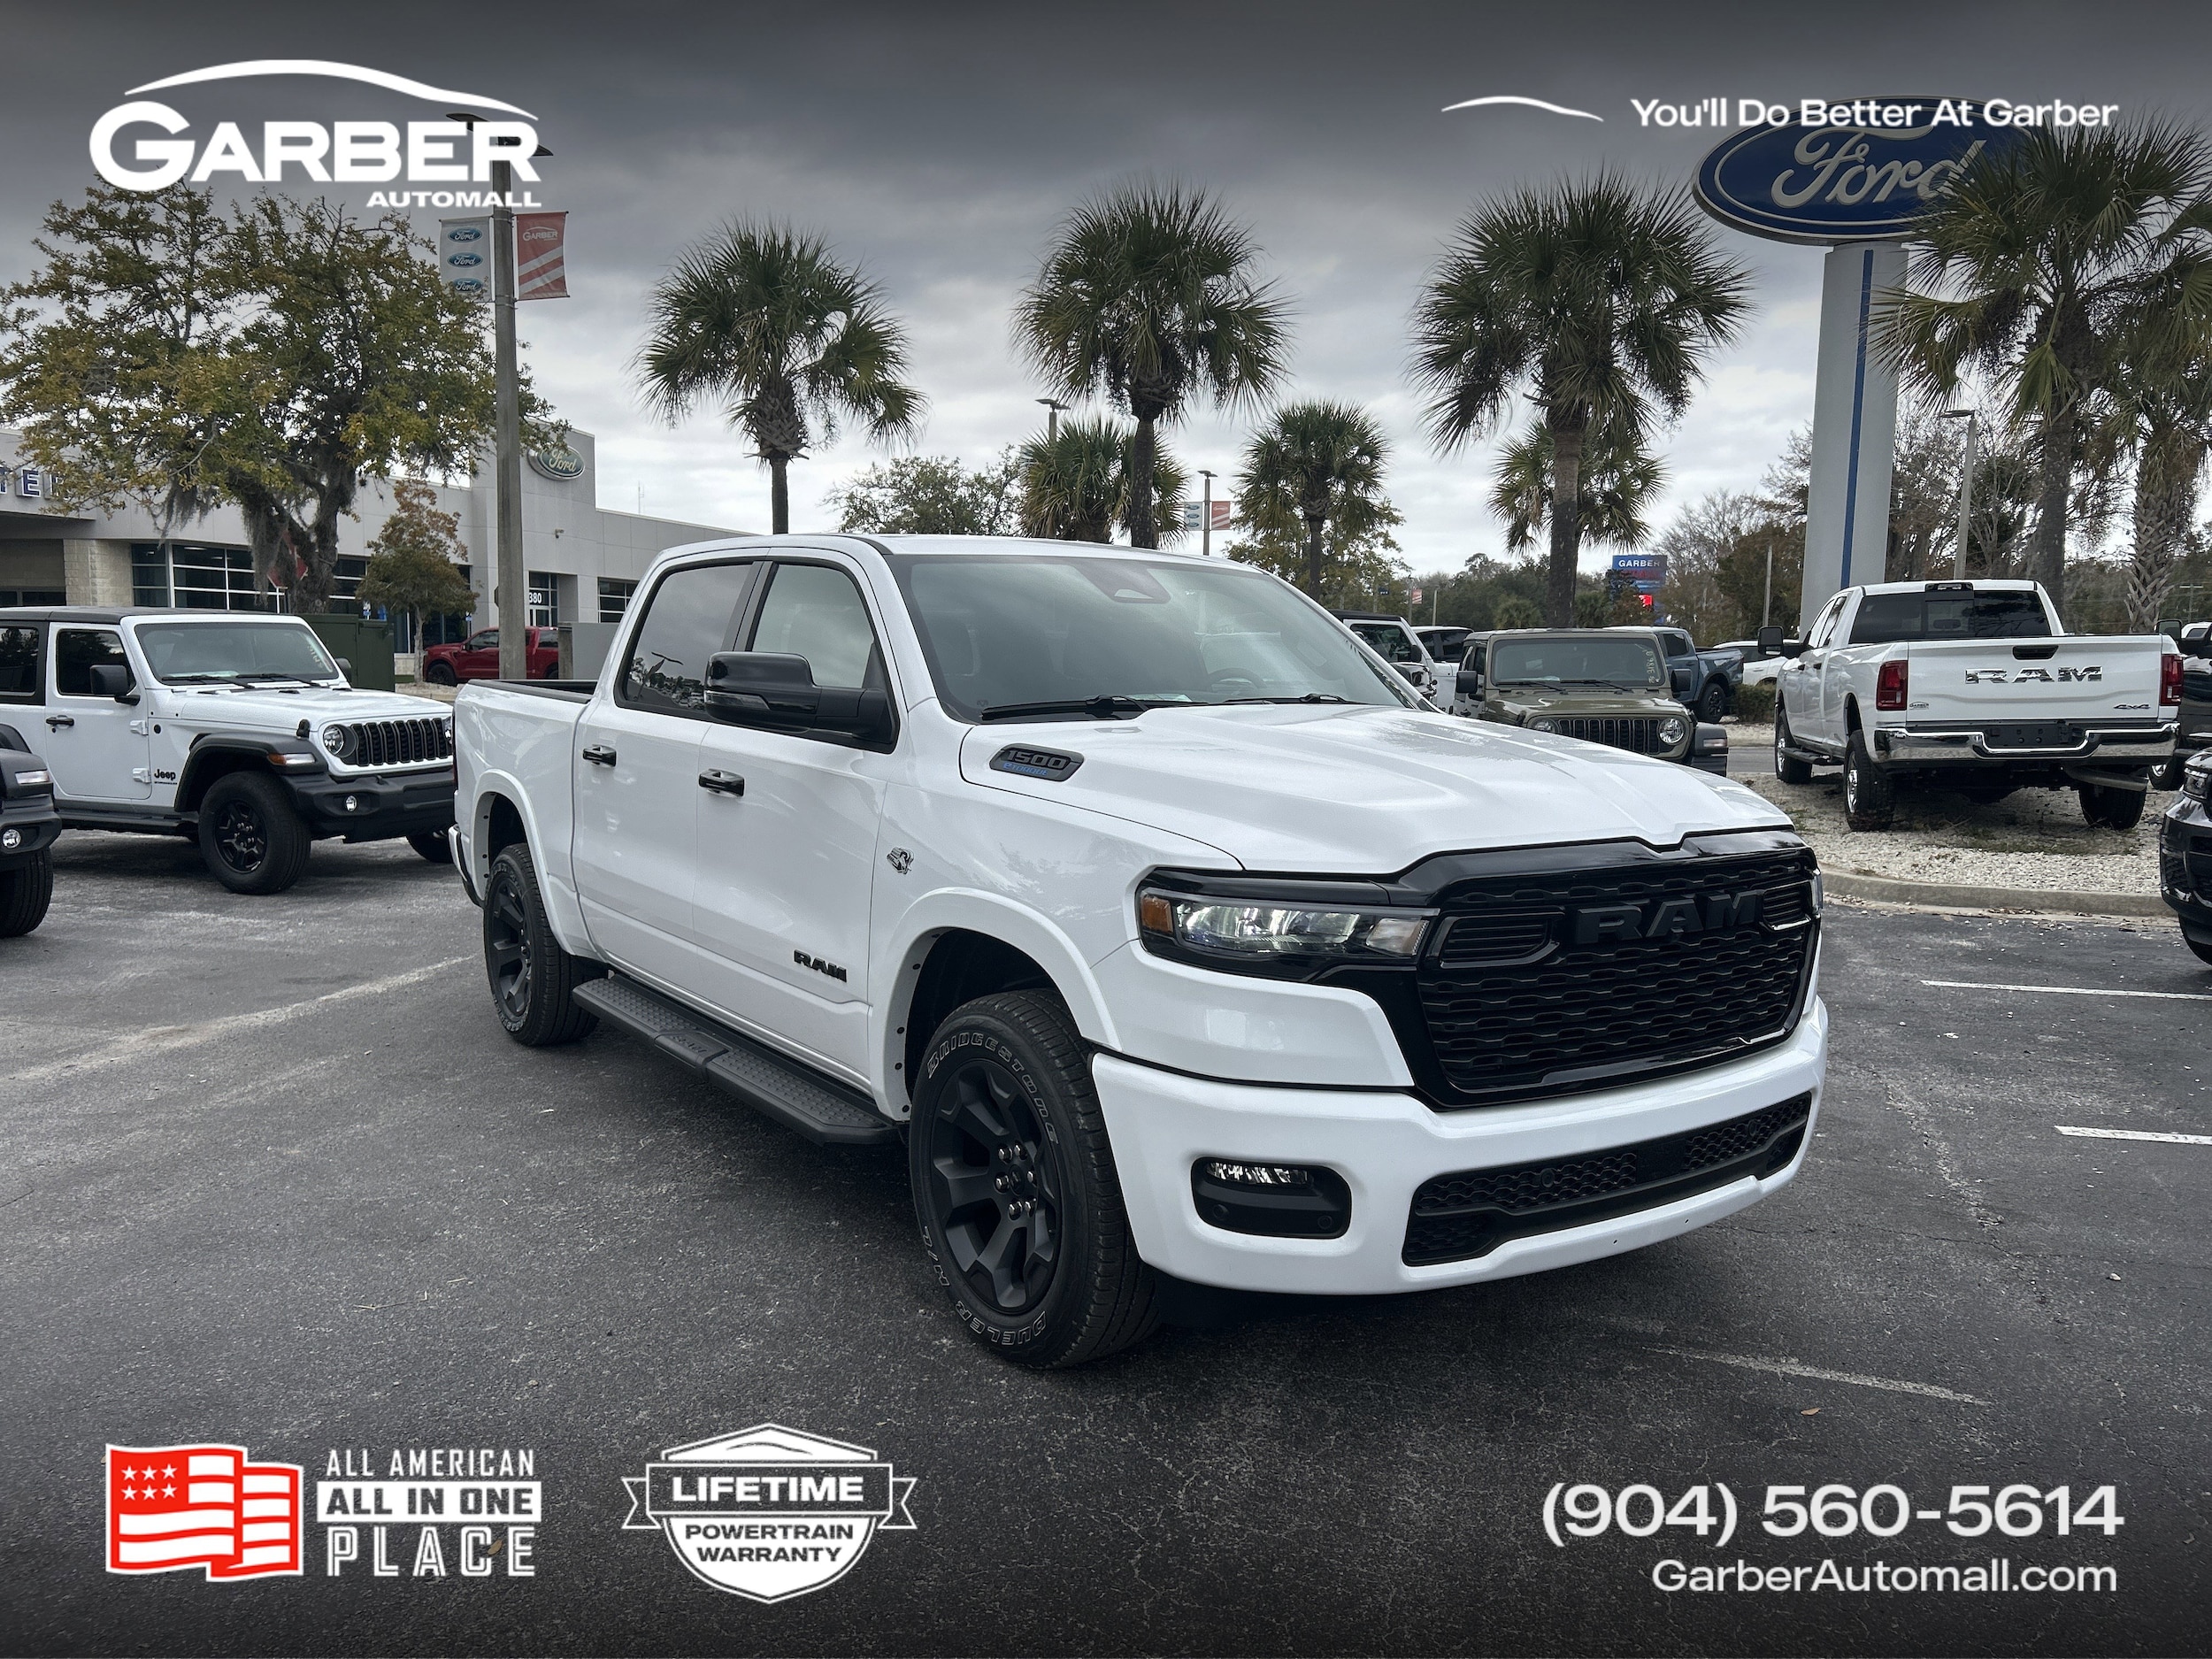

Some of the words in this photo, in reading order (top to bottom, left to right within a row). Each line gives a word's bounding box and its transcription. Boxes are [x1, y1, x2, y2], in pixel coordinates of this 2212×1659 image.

[1770, 126, 1987, 208] Ford
[454, 229, 475, 242] Ford
[522, 231, 558, 242] GARBER
[453, 255, 476, 266] Ford
[456, 280, 478, 292] Ford
[549, 448, 577, 472] Ford
[1965, 666, 2103, 684] RAM
[1007, 749, 1068, 769] 1500
[154, 769, 176, 781] Jeep
[1577, 890, 1758, 944] RAM
[794, 949, 848, 983] RAM
[927, 1032, 1059, 1144] BRIDGESTONE
[956, 1301, 1047, 1346] DUELER
